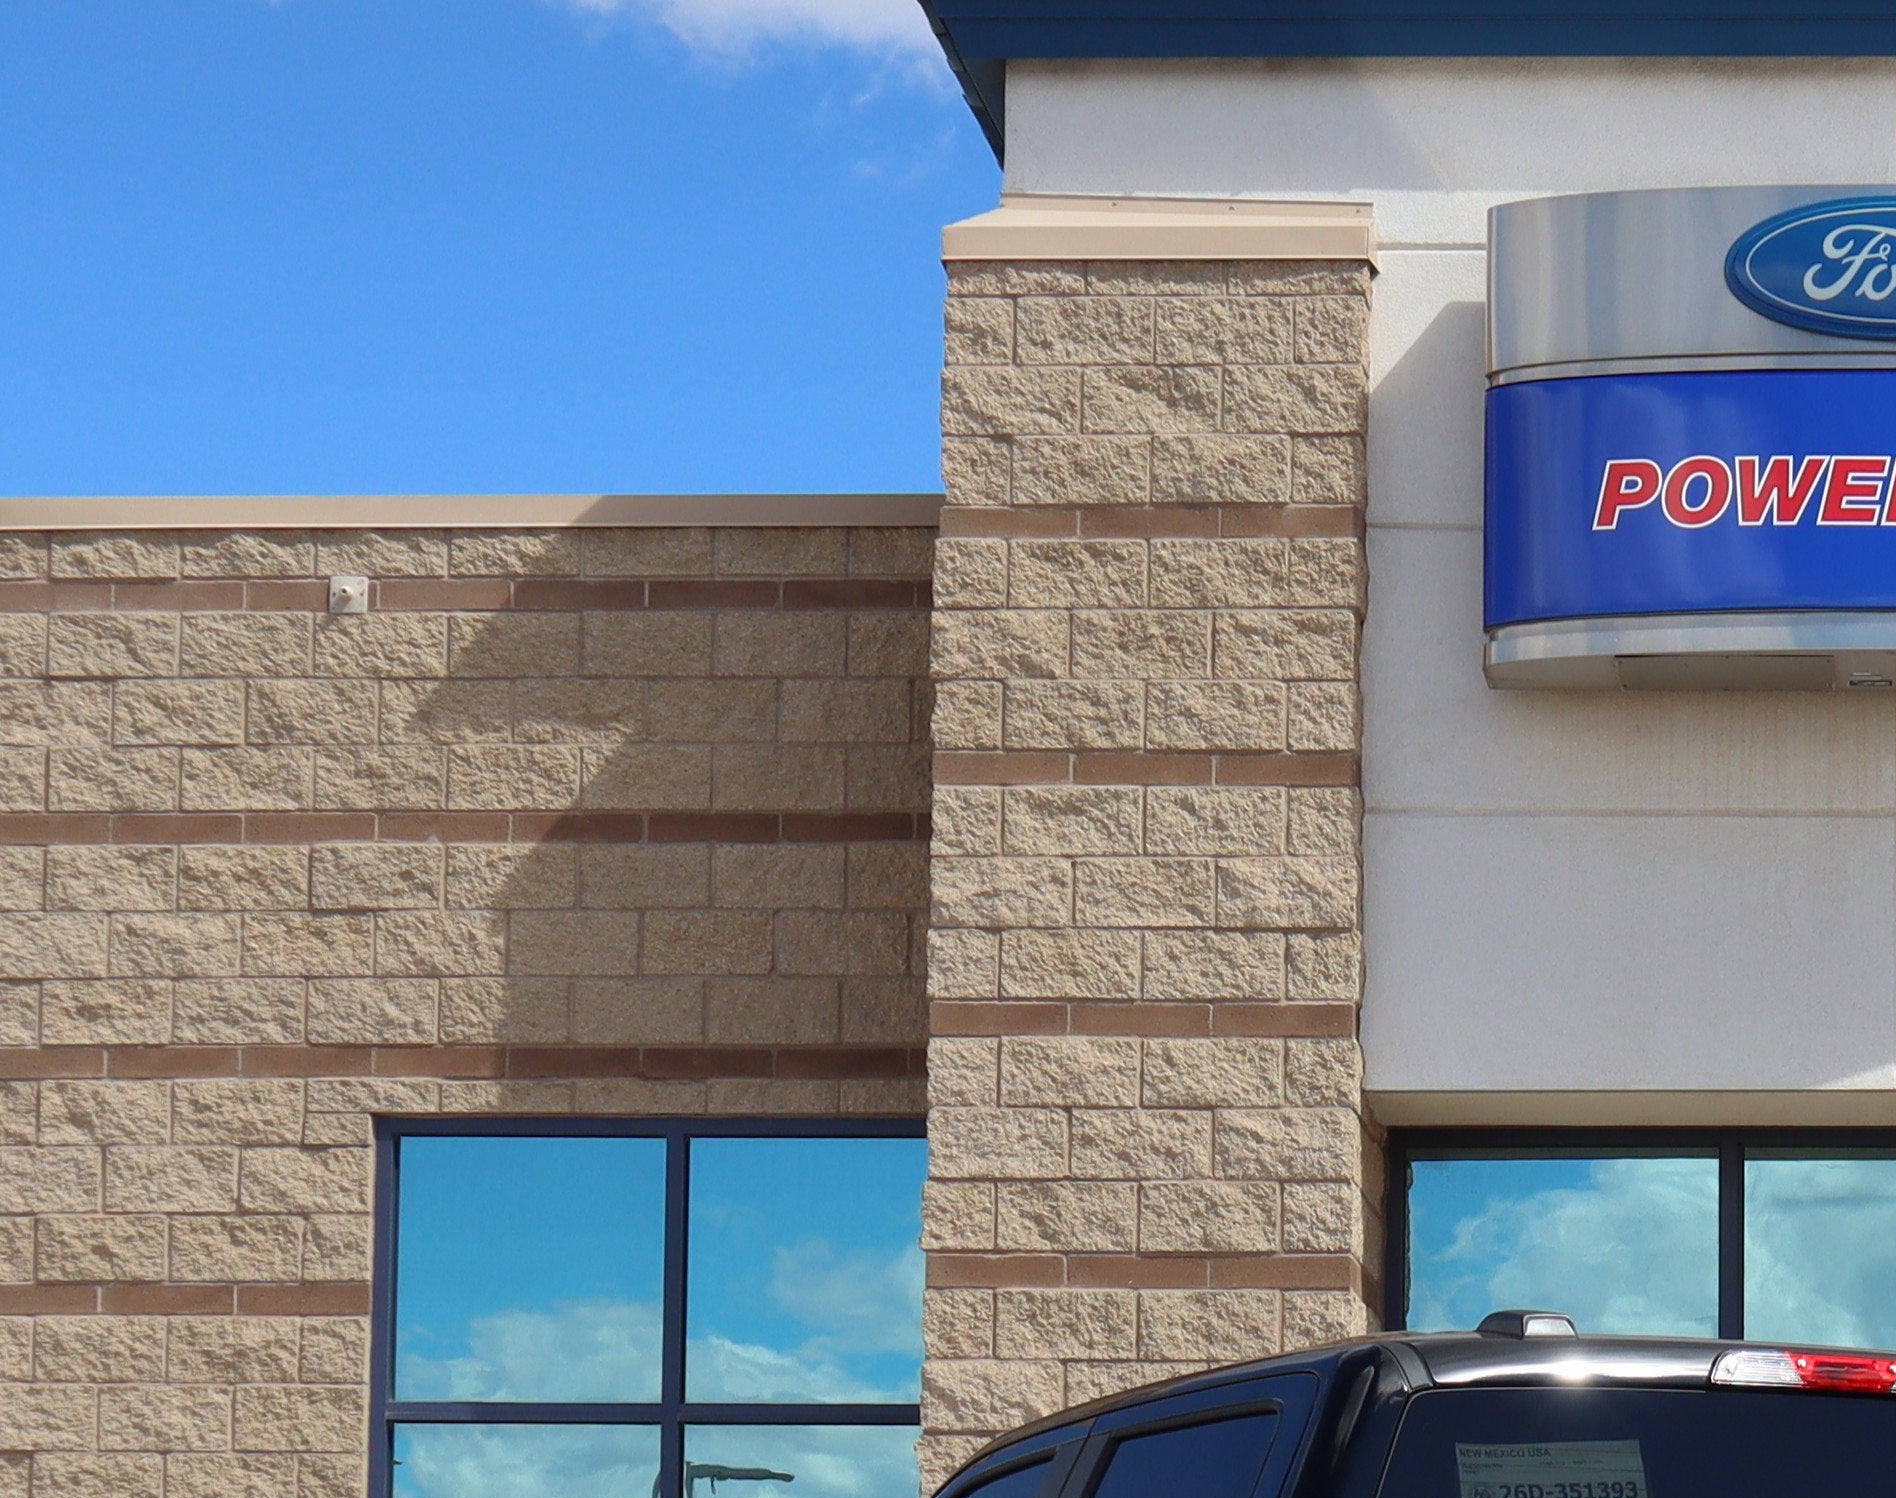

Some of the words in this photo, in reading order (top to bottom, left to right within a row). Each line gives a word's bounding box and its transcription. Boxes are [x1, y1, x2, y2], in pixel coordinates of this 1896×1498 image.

[1459, 1448, 1482, 1458] NEW
[1484, 1447, 1525, 1458] MEXICO
[1527, 1447, 1551, 1458] USA
